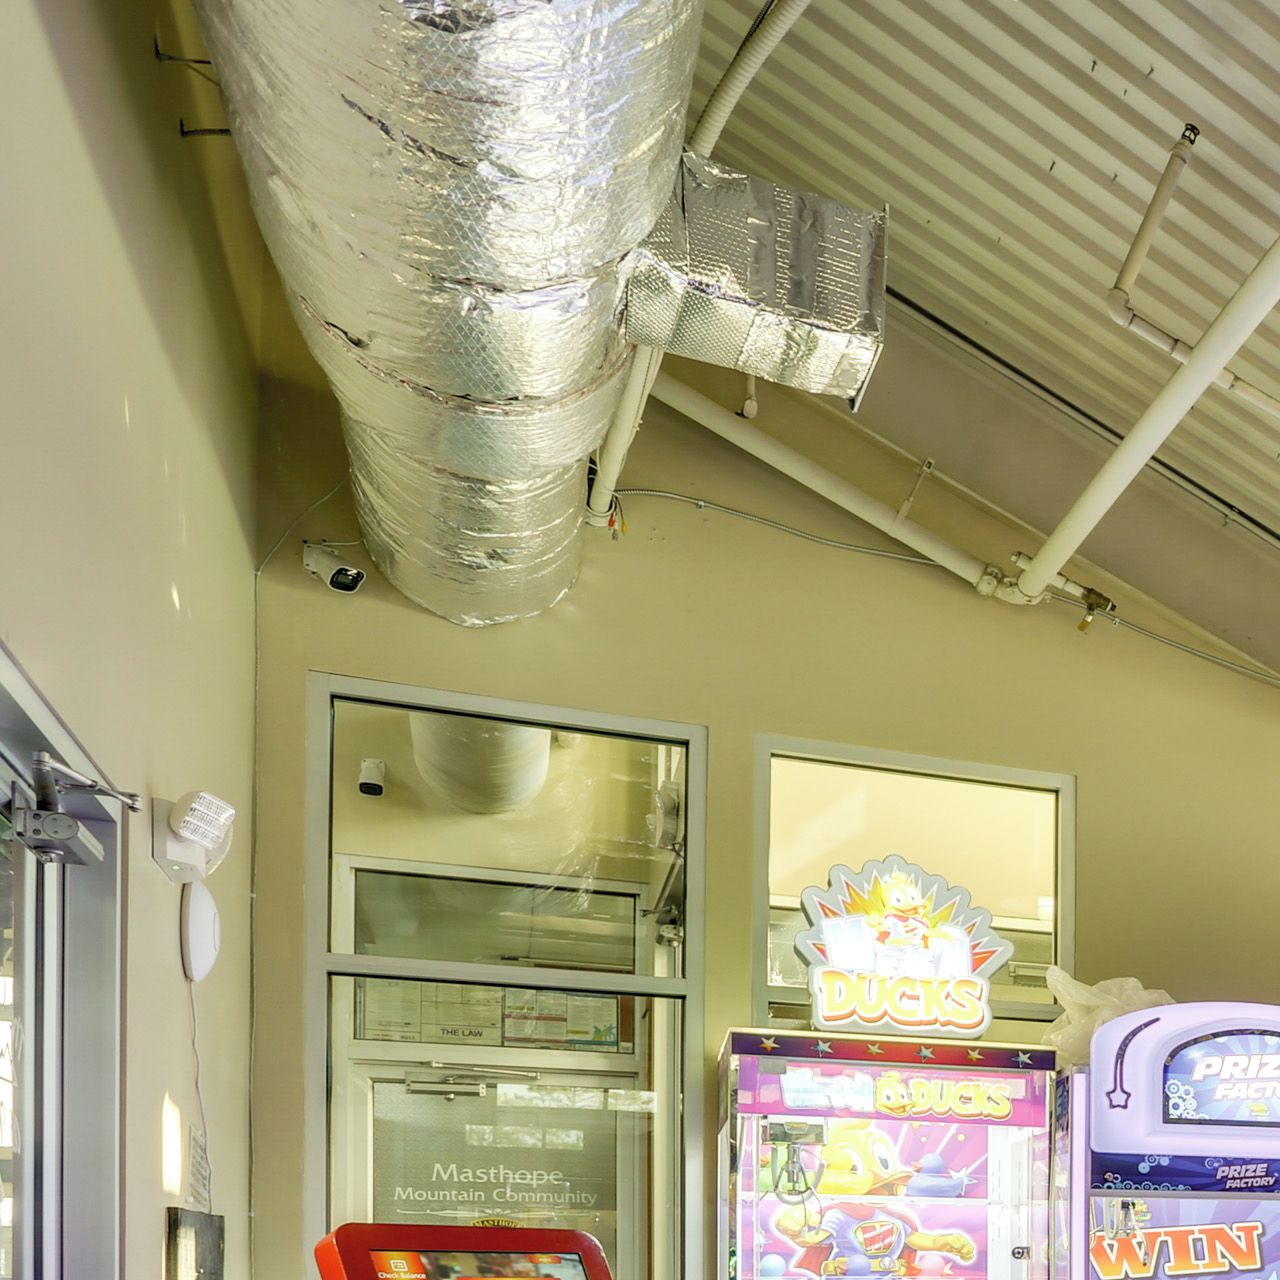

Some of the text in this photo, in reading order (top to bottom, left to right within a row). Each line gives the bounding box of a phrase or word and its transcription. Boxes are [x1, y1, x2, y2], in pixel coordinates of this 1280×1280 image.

[819, 969, 985, 1030] DUCKS
[440, 1028, 484, 1038] THE LAW
[909, 1078, 1012, 1120] DUCKS
[431, 1162, 564, 1188] Masthope
[1216, 1163, 1269, 1180] PRIZE
[1225, 1175, 1276, 1189] FACTORY
[394, 1186, 598, 1206] Mountain Community
[1089, 1221, 1264, 1280] WIN
[378, 1271, 427, 1280] Check Balance
